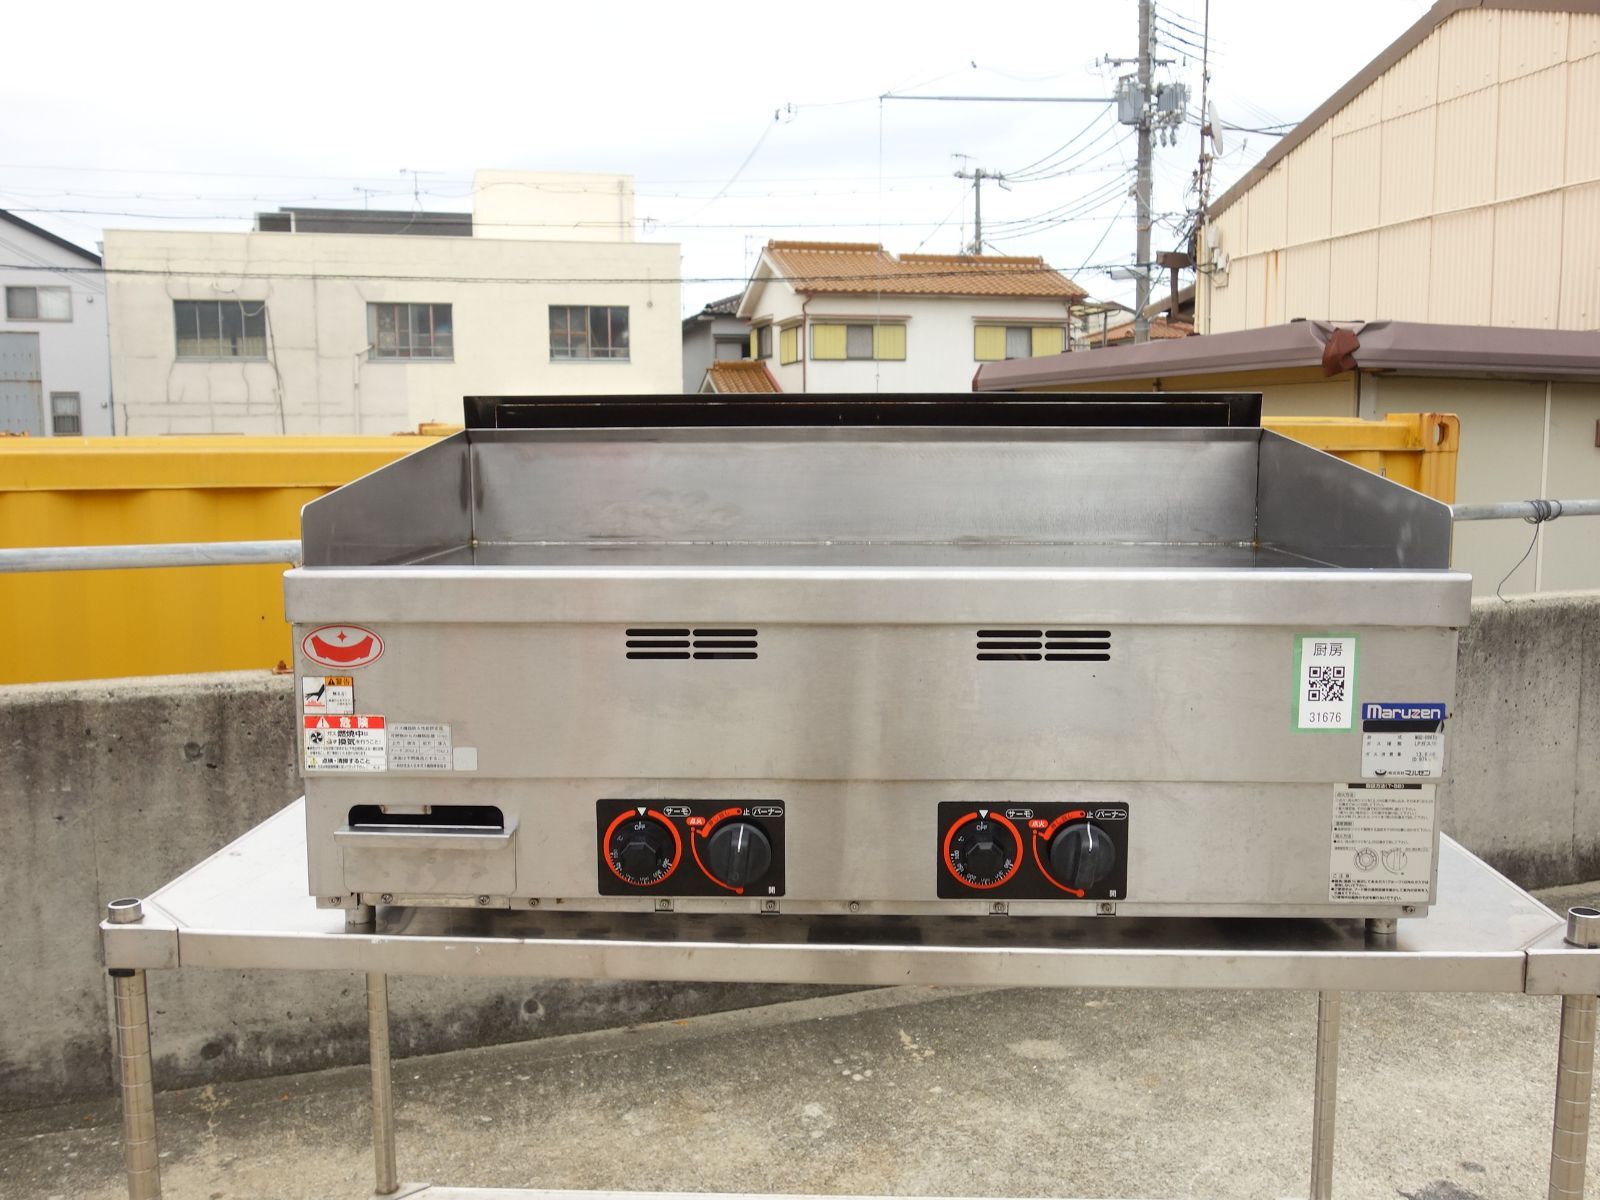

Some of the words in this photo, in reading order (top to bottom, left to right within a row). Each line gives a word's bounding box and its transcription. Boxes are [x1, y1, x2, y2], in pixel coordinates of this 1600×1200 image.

[1313, 642, 1343, 657] 厨房
[1309, 711, 1342, 723] 31676
[665, 807, 689, 816] サーモ
[753, 807, 782, 816] バーナー
[1007, 810, 1032, 818] サーモ
[1097, 810, 1126, 819] バーナー
